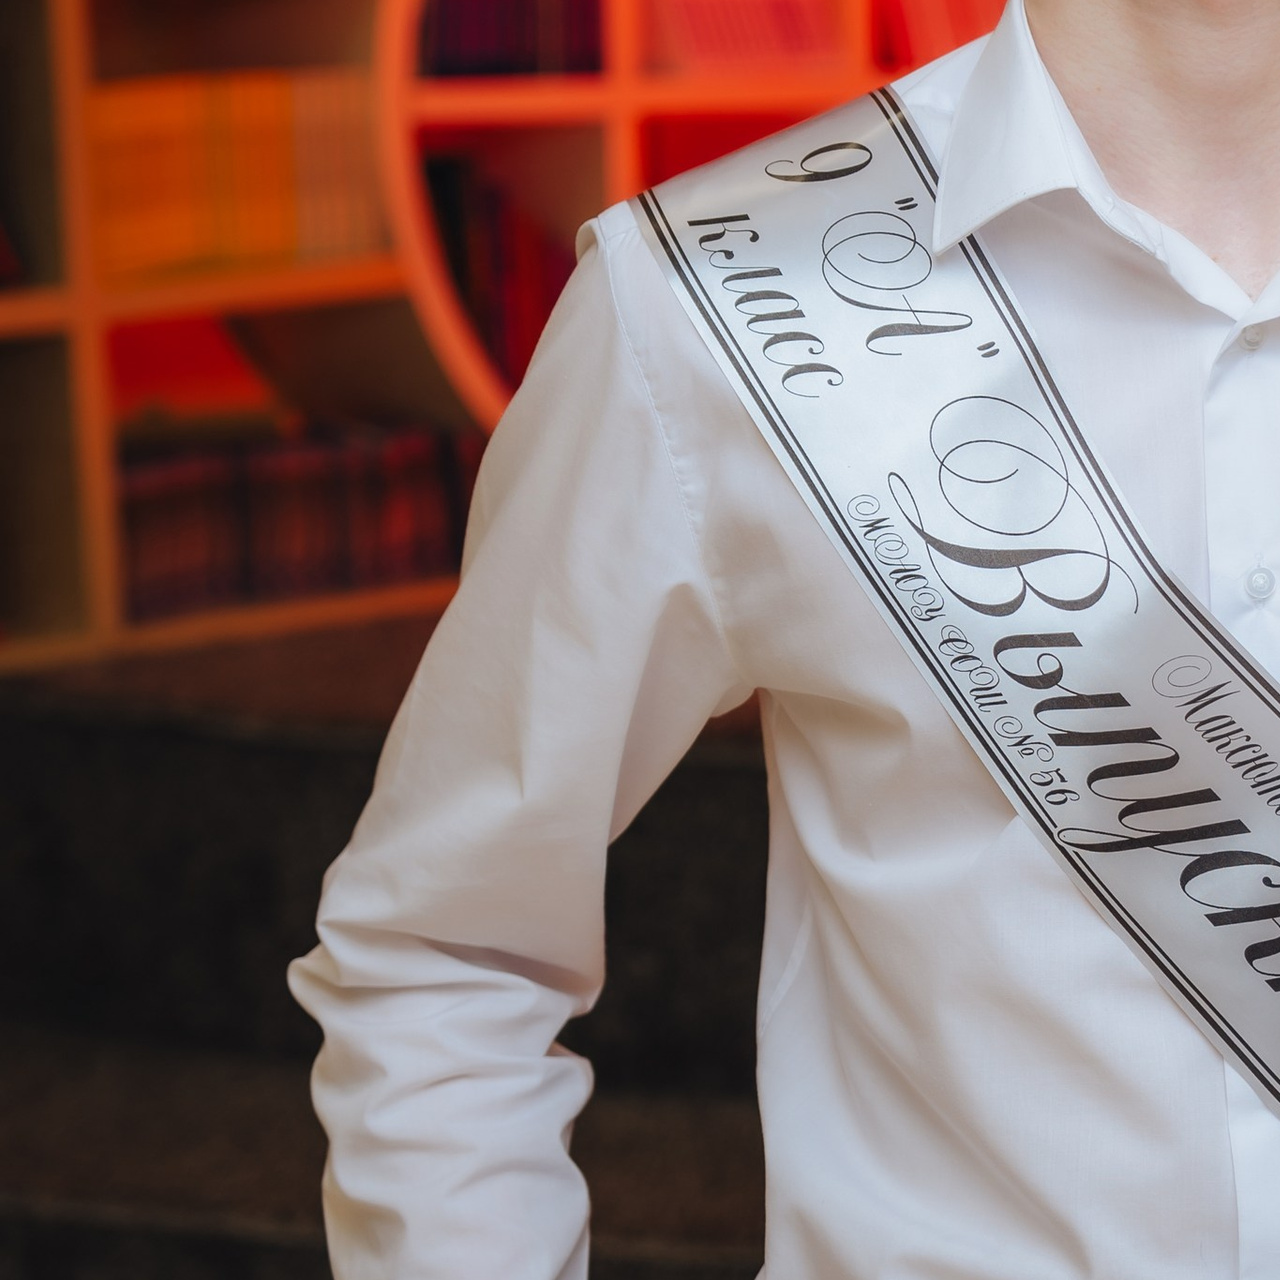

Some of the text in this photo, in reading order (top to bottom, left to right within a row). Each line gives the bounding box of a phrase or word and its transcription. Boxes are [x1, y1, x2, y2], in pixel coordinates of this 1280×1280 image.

[764, 141, 873, 183] 9
[686, 213, 844, 398] класс
[847, 494, 946, 622] МАОУ
[938, 624, 1009, 713] СОШ
[1029, 767, 1081, 806] 56
